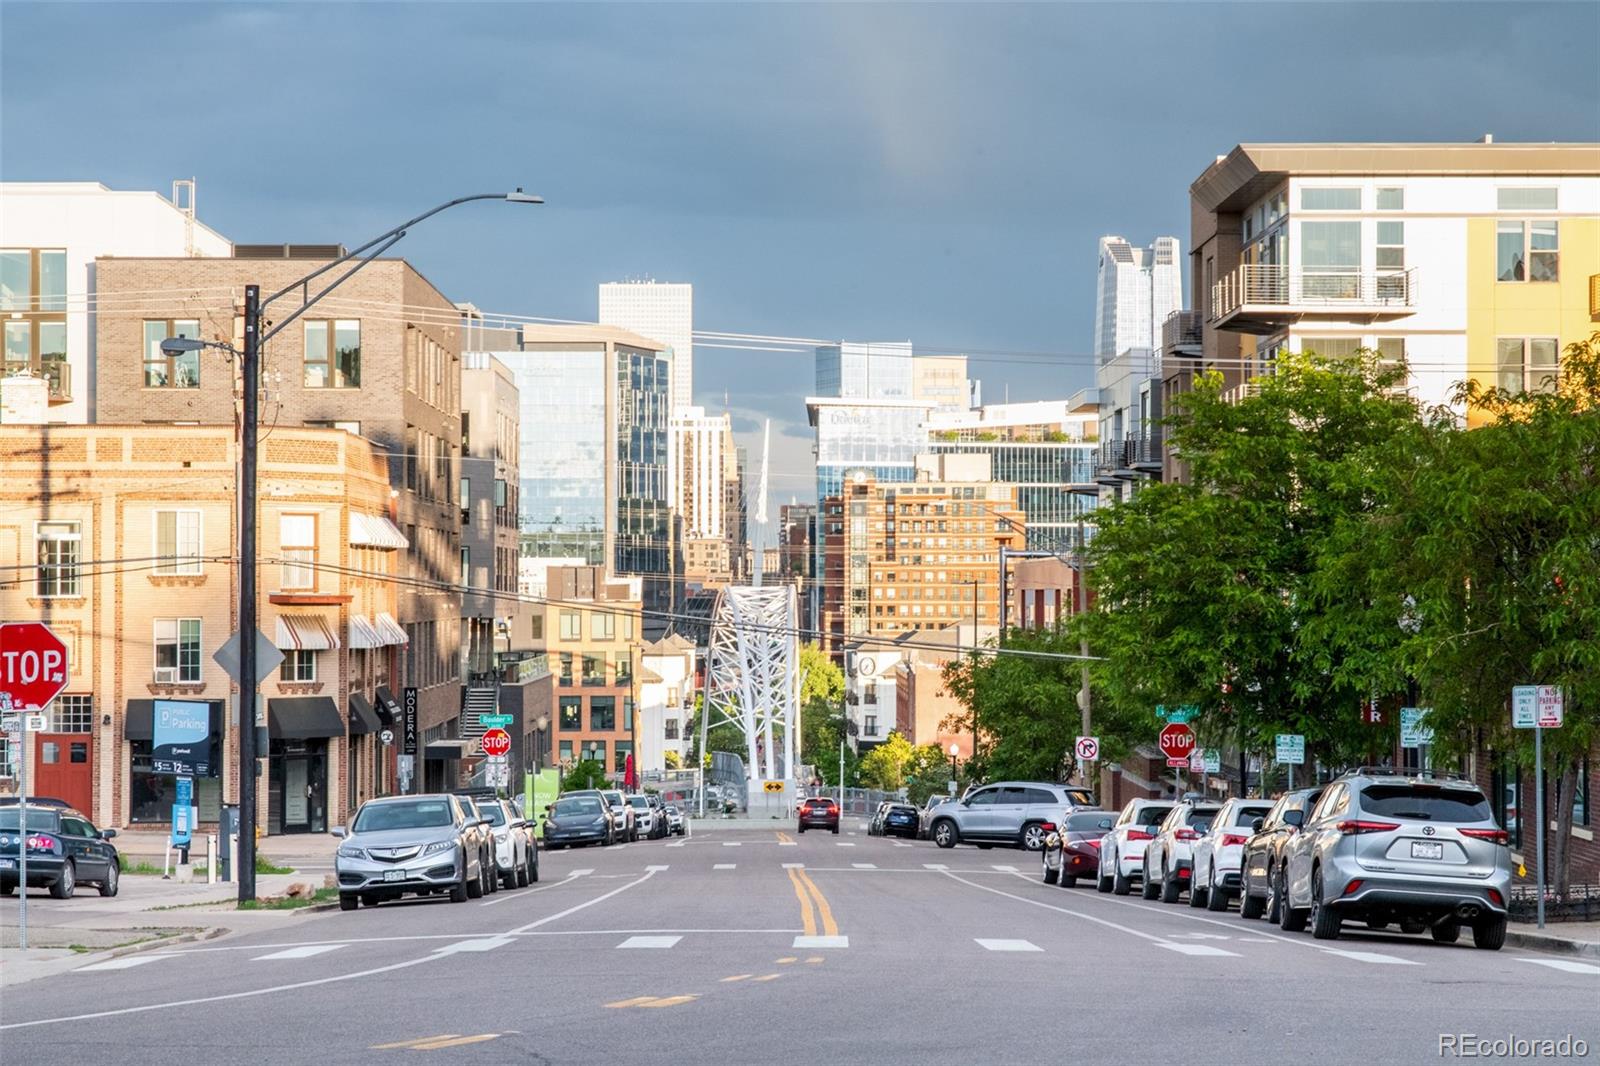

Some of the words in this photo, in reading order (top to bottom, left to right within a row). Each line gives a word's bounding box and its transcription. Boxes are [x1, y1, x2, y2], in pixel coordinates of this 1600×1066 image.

[0, 651, 62, 683] TOP
[406, 690, 415, 740] MODERA
[172, 718, 206, 733] Parking
[484, 737, 508, 748] STOP
[1163, 734, 1193, 748] STOP
